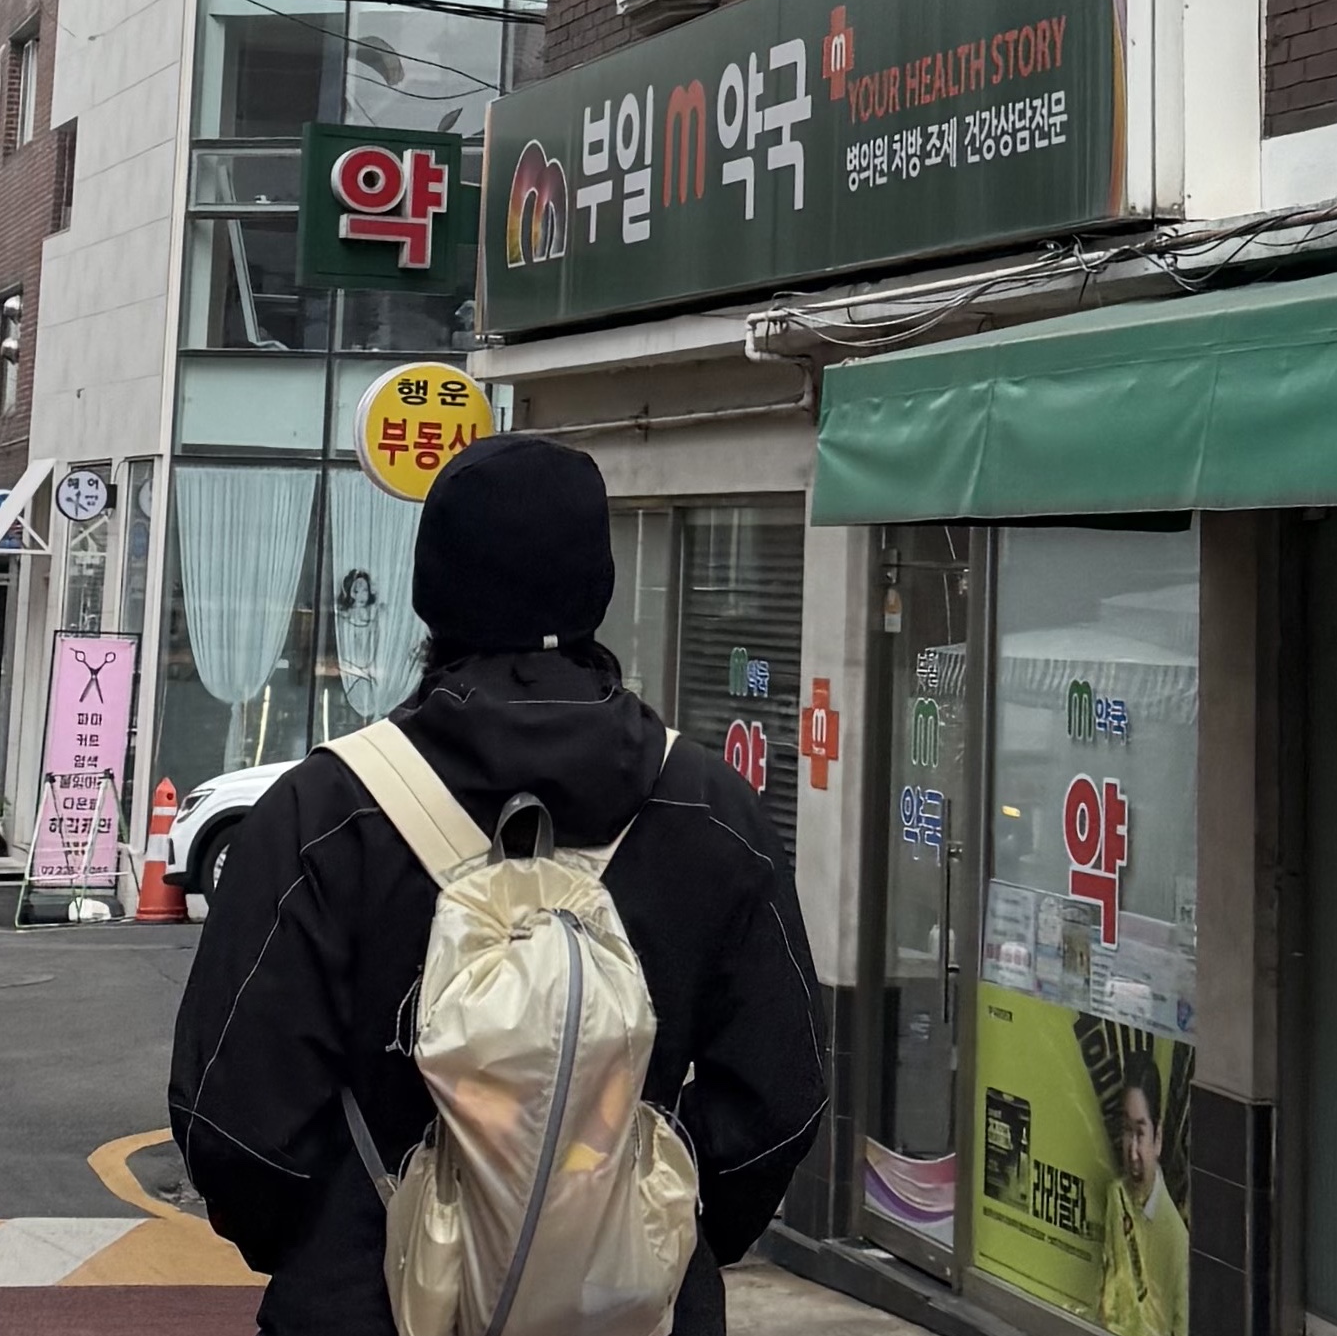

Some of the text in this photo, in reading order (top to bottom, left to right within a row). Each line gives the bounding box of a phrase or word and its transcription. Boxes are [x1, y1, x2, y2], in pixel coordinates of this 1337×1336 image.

[847, 15, 1067, 126] YOUR HEALTH STORY
[576, 84, 654, 245] 부일
[717, 38, 813, 221] 약국
[846, 90, 1068, 192] 병의원 처방 조제 건강상담전문
[331, 146, 448, 269] 약
[1063, 773, 1128, 950] 약
